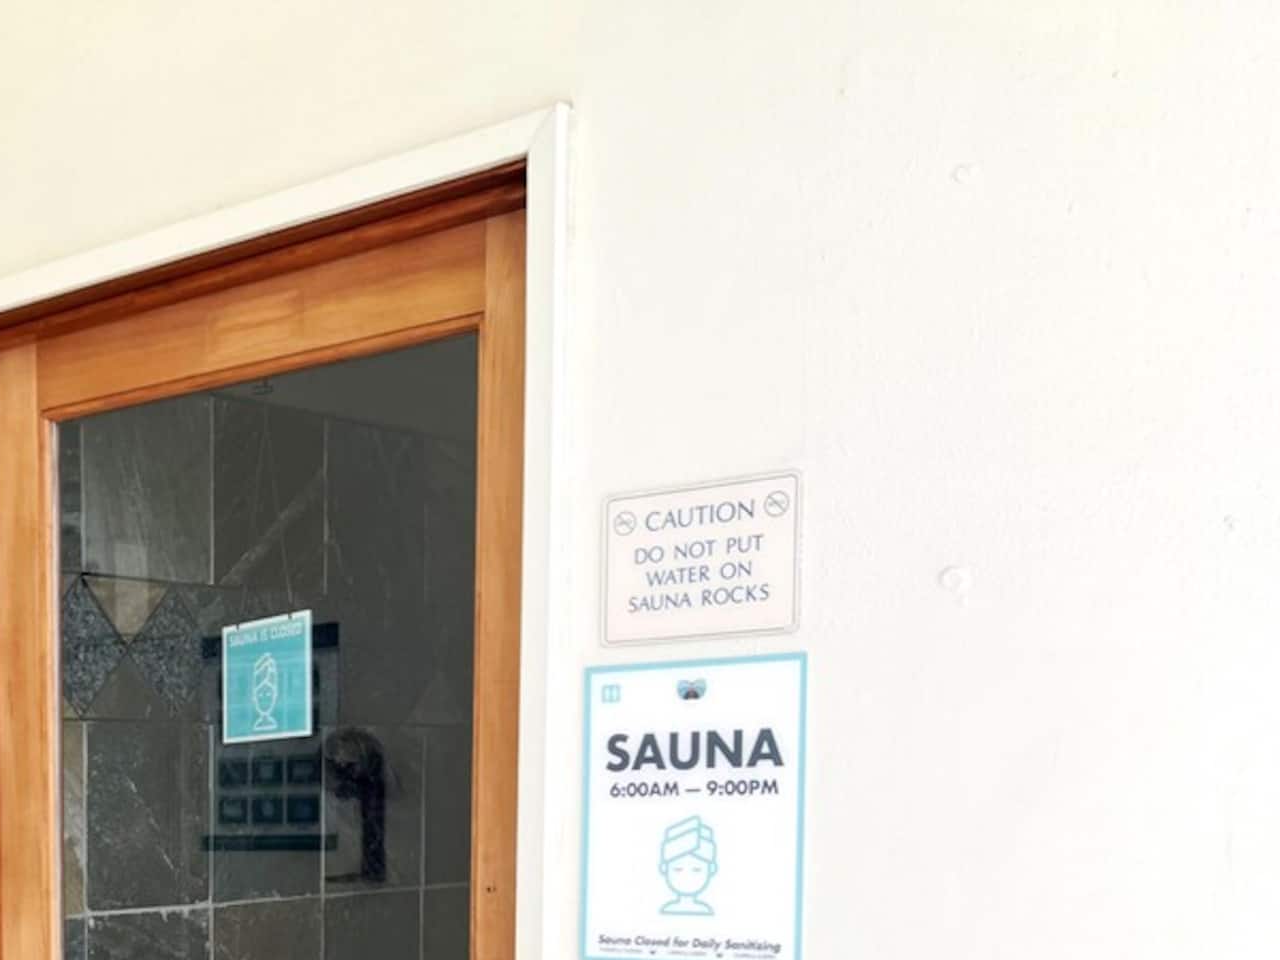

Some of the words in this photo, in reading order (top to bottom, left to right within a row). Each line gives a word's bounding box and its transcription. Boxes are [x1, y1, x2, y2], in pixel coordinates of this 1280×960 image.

[645, 499, 755, 532] CAUTION
[634, 546, 664, 564] DO
[674, 540, 716, 559] NOT
[726, 534, 764, 554] PUT
[646, 565, 710, 587] WATER
[720, 561, 752, 580] ON
[628, 592, 692, 613] SAUNA
[702, 583, 769, 606] ROCKS
[606, 728, 784, 772] SAUNA
[610, 781, 680, 798] 6:00AM
[706, 779, 779, 796] 9:00PM
[599, 934, 631, 945] Sauna
[634, 936, 670, 947] Closed
[673, 937, 689, 948] for
[692, 938, 721, 951] Daily
